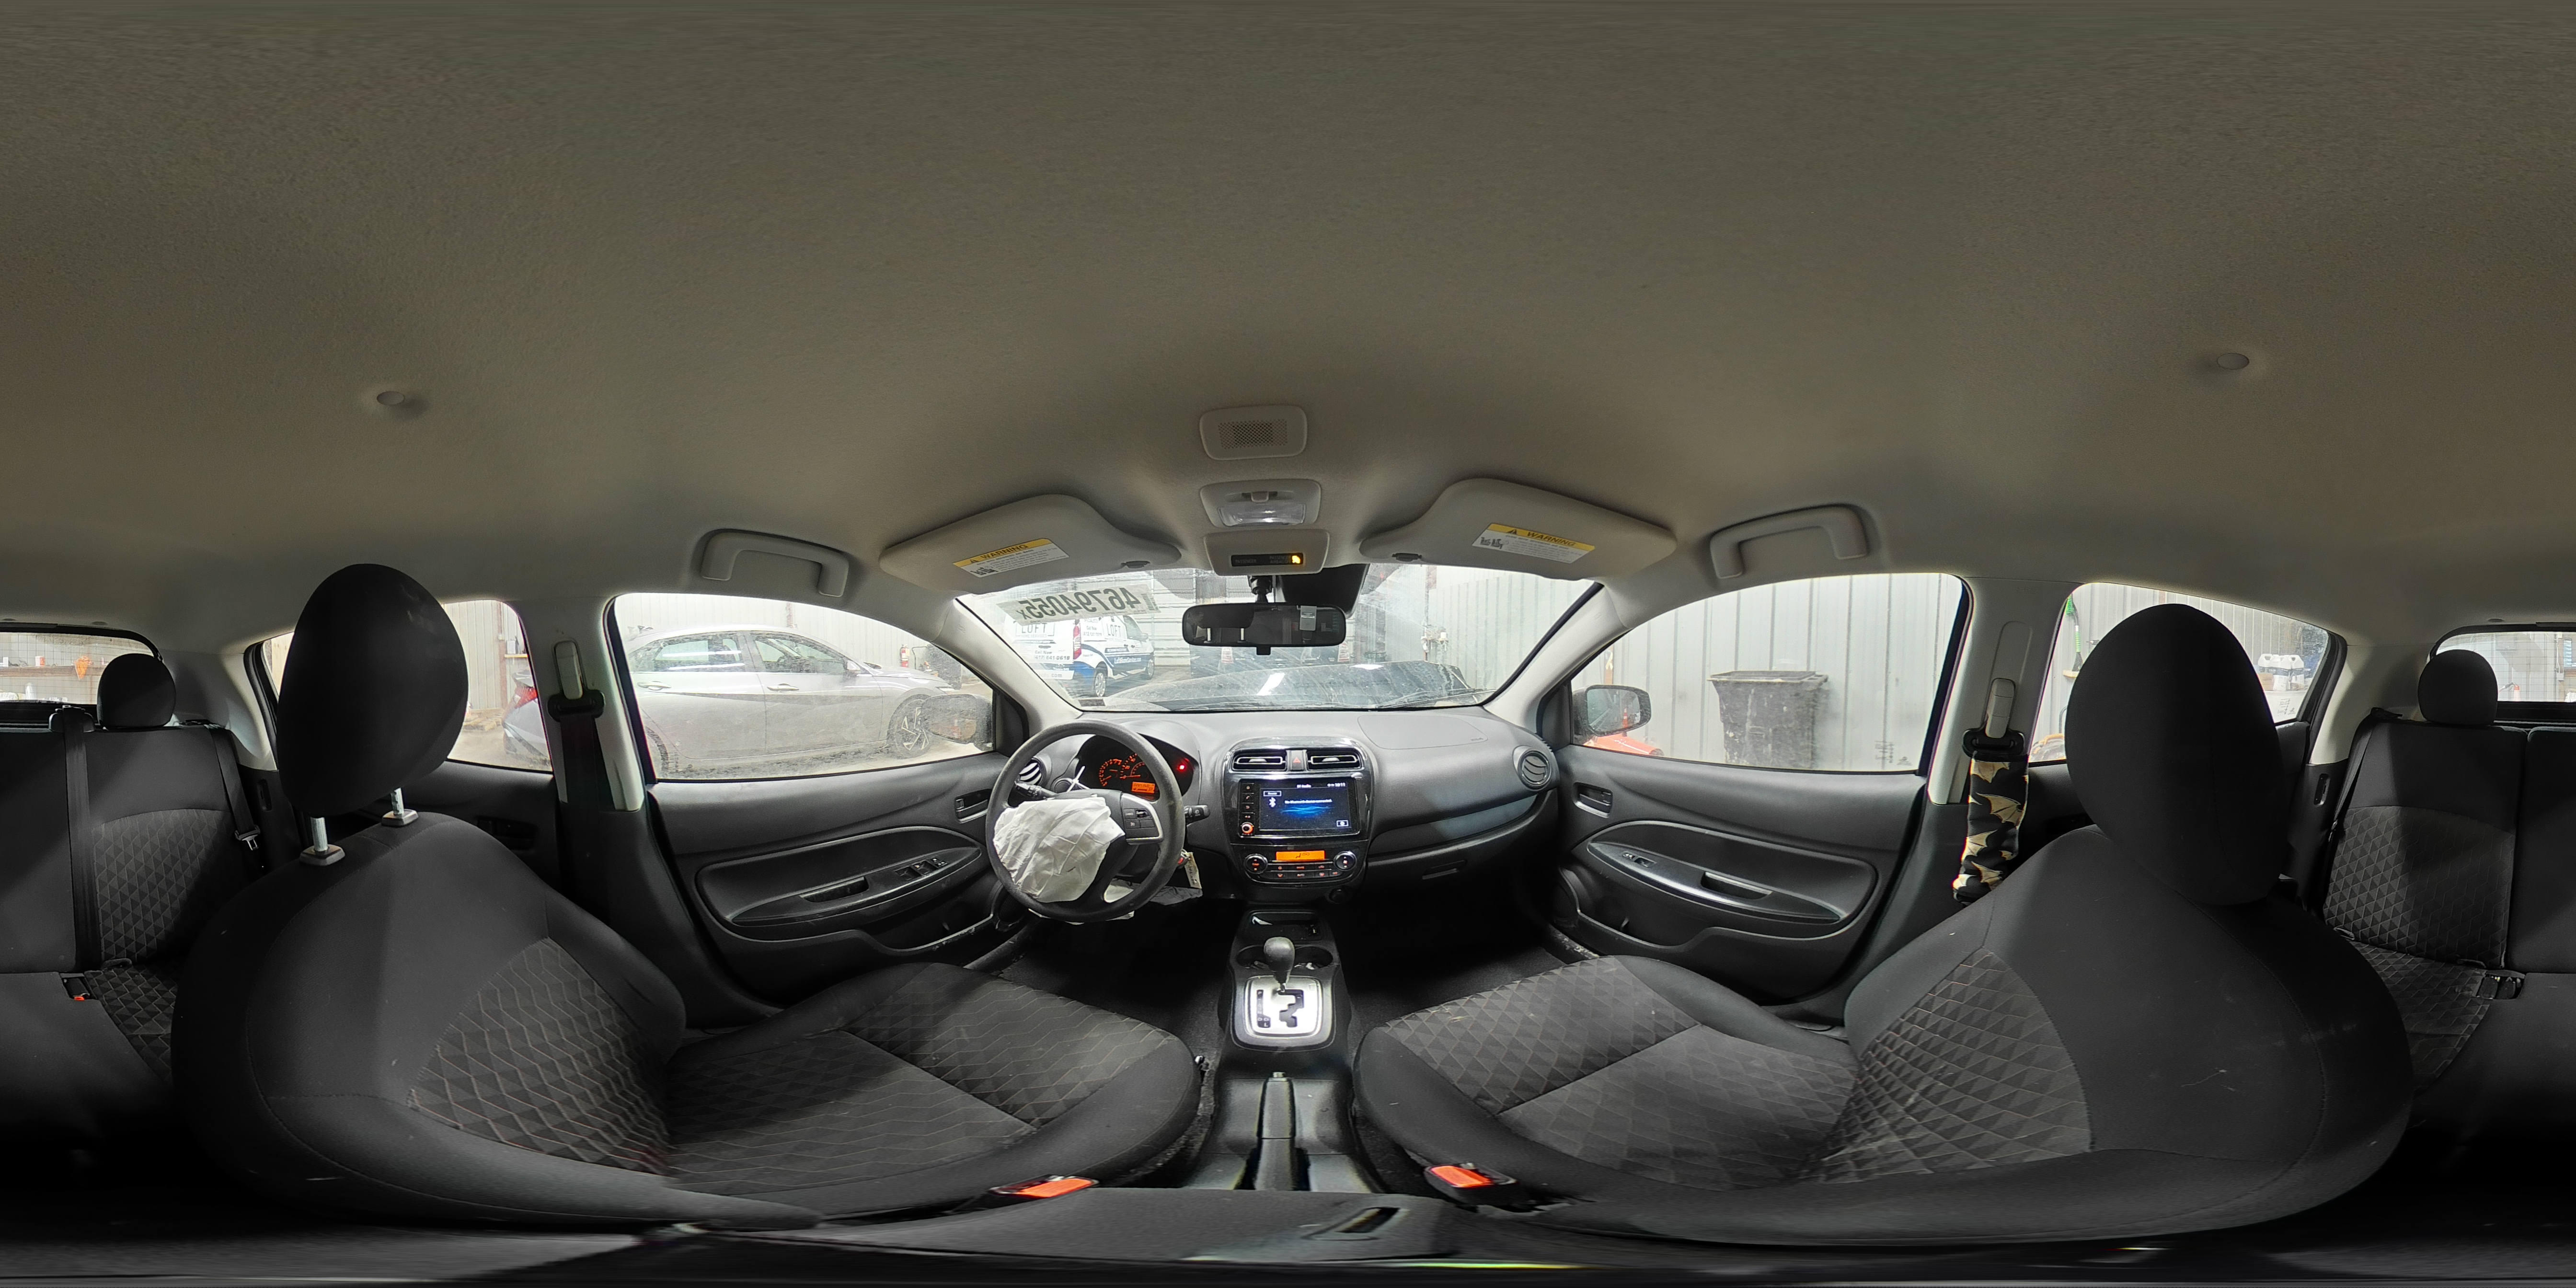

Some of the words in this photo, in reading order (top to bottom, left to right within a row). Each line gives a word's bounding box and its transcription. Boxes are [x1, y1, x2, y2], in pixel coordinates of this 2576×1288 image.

[1527, 532, 1576, 547] WARNING
[981, 544, 1029, 559] WARNING
[1106, 623, 1121, 637] LOFT
